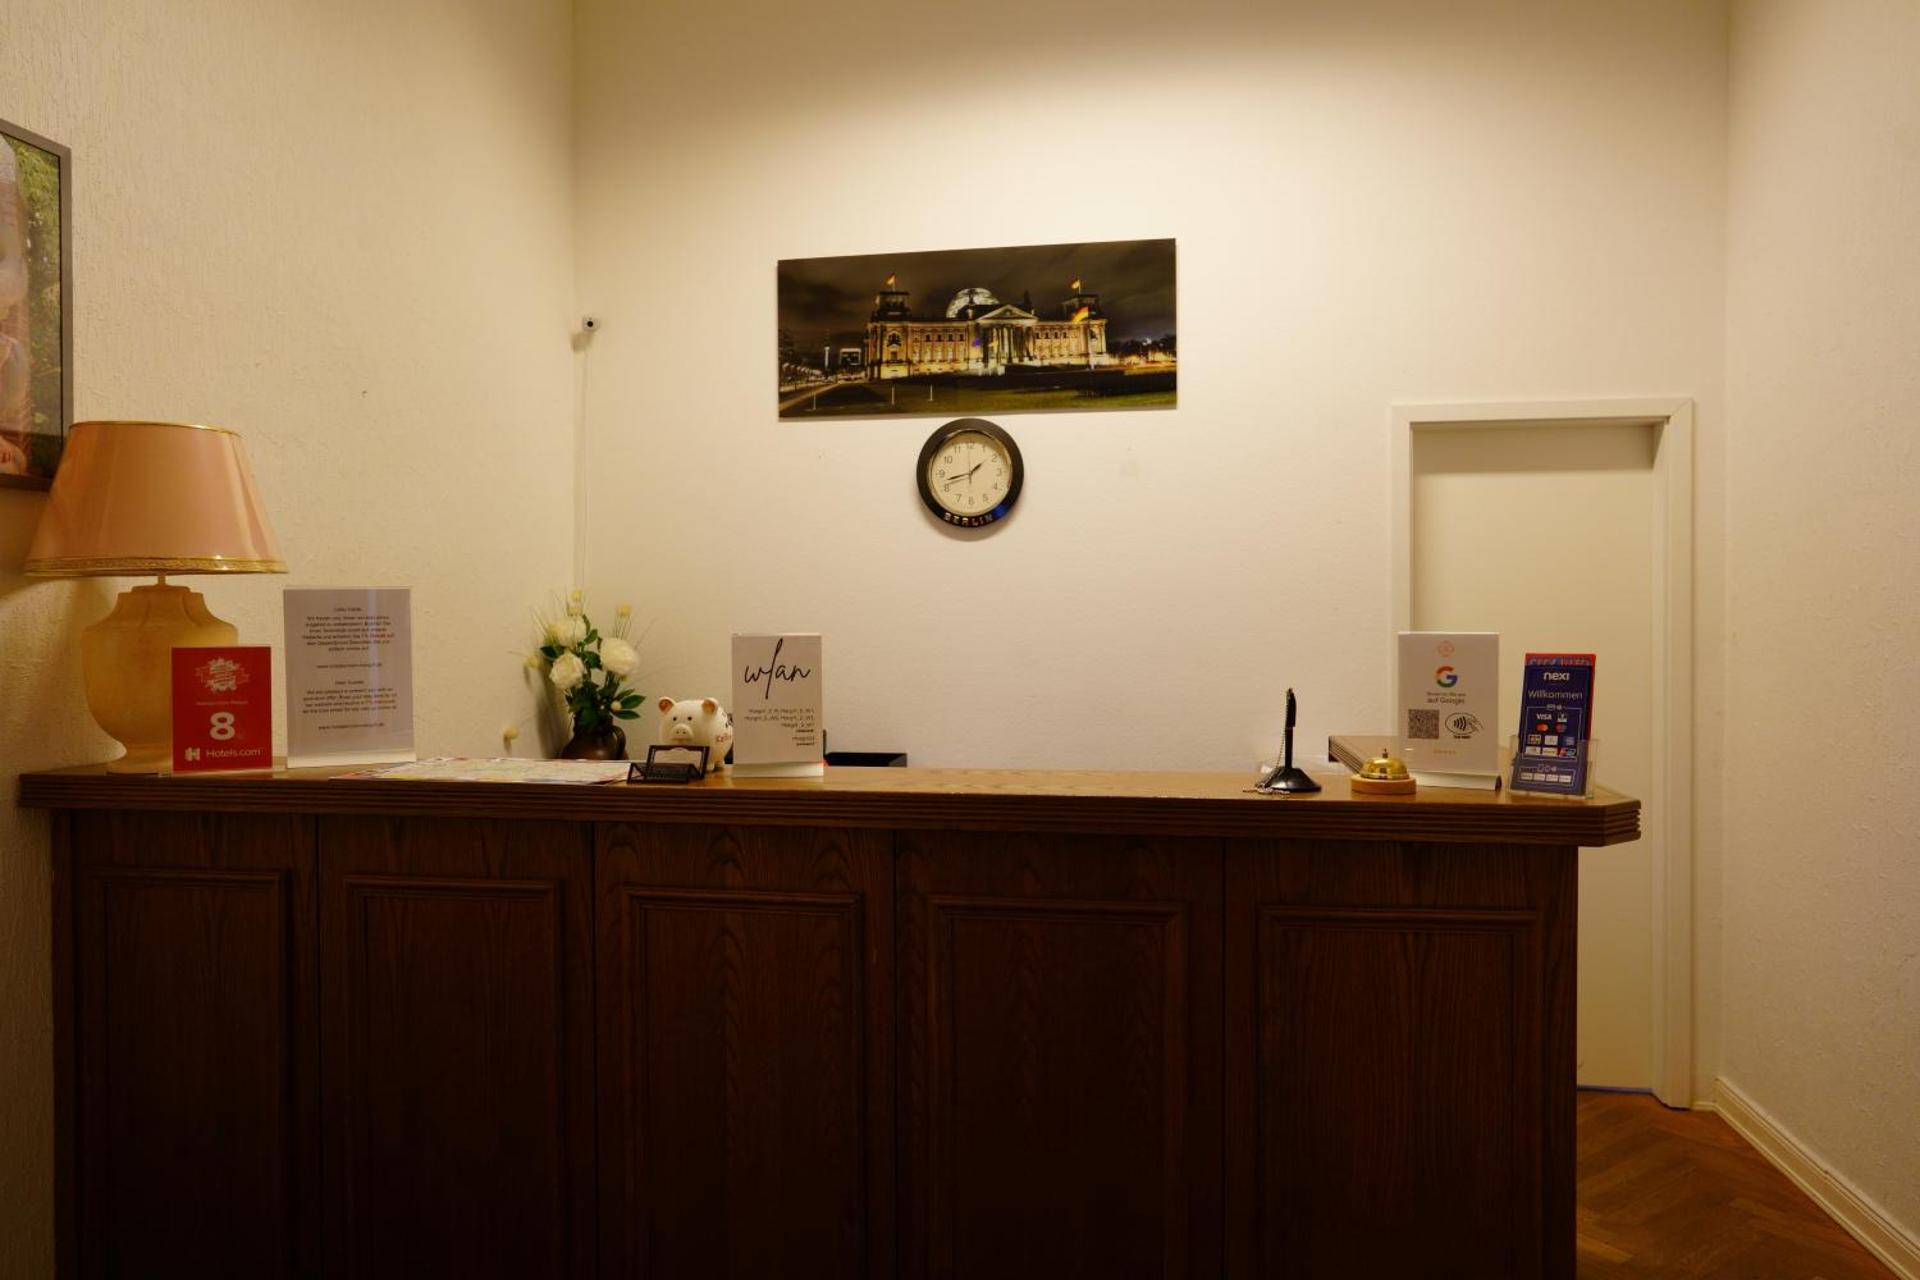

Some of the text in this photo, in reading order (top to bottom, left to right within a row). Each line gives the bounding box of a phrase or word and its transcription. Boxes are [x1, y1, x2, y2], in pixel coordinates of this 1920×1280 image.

[943, 512, 993, 527] BERLIN
[744, 637, 811, 699] wlan
[1543, 671, 1571, 681] nexi
[1528, 688, 1583, 700] Willkommen
[209, 711, 236, 741] 8
[206, 747, 261, 758] Hotels.com
